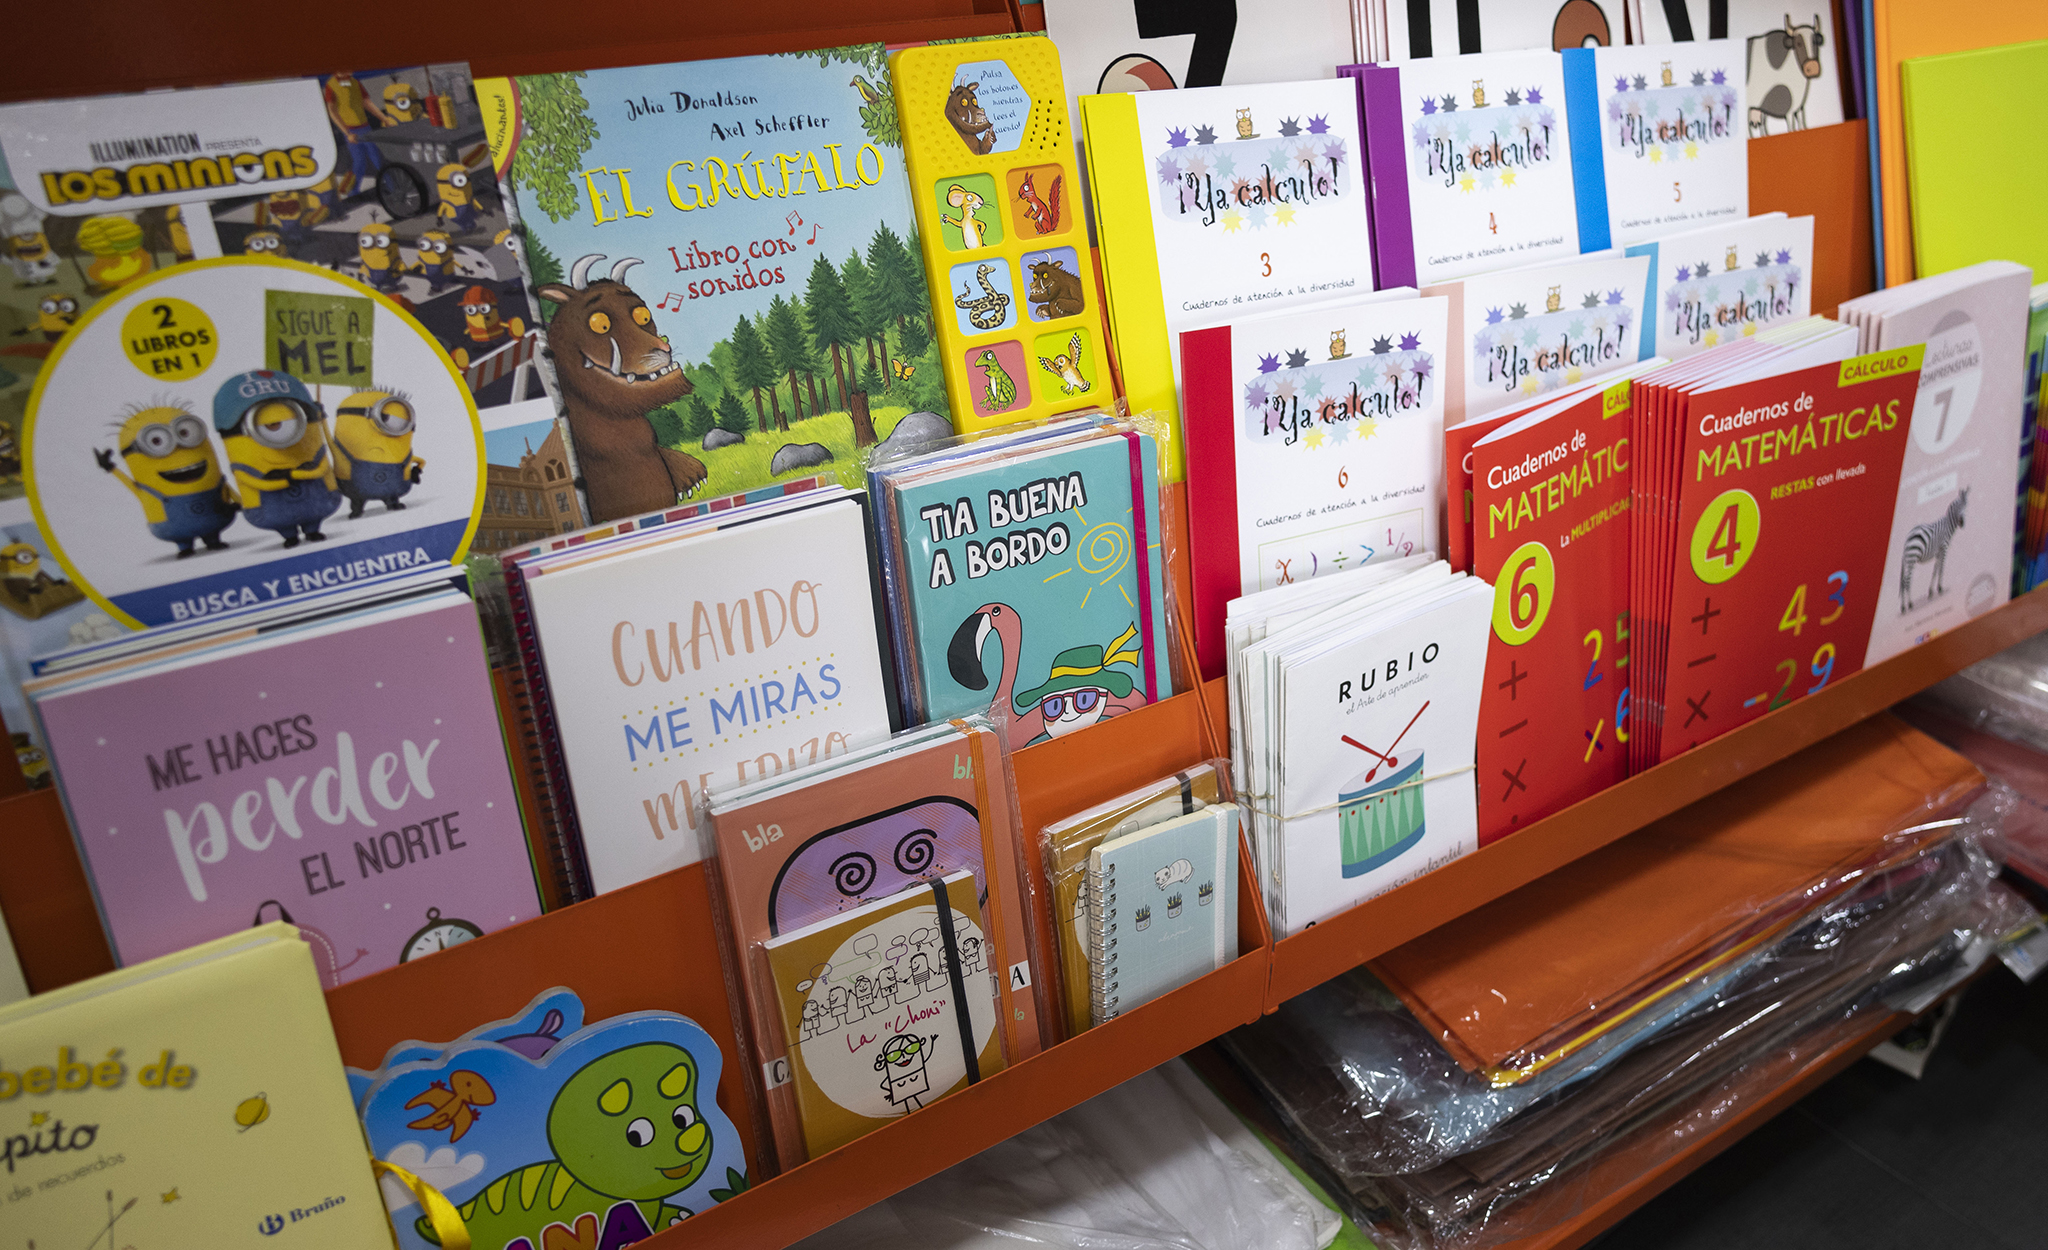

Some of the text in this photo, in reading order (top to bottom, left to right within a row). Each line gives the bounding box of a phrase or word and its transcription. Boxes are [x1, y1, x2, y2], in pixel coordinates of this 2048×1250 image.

[625, 91, 759, 121] Julia Donaldson
[710, 114, 830, 141] Axel Scheffler
[89, 132, 262, 162] ILLUMINATION PRESENTA
[1472, 125, 1550, 173] calculo!
[579, 142, 886, 227] EL GRÚFALO
[1237, 157, 1339, 208] calculo!
[1672, 182, 1682, 203] 5
[1488, 212, 1498, 235] 4
[668, 234, 797, 274] Libro con
[1260, 252, 1272, 277] 3
[688, 262, 786, 300] sonidos
[1182, 278, 1355, 312] Cuadernos de atención a la diversidad
[153, 305, 176, 329] 2
[276, 308, 361, 338] SIGUE A
[132, 328, 211, 356] LIBROS
[277, 339, 367, 377] MEL
[150, 353, 203, 375] EN 1
[1844, 354, 1908, 381] CÁLCULO
[1918, 353, 1979, 388] OMPRENSIVAS
[239, 381, 290, 398] GRU
[1323, 372, 1423, 425] calculo!
[1700, 391, 1814, 437] Cuadernos de
[1487, 442, 1567, 489] Cuadernos
[1571, 429, 1586, 452] de
[1696, 399, 1900, 483] MATEMÁTICAS
[1338, 465, 1348, 488] 6
[1770, 475, 1815, 500] RESTAS
[1816, 472, 1834, 487] con
[920, 471, 1088, 542] TIA BUENA
[1256, 511, 1302, 528] Cuadernos
[1306, 506, 1317, 517] de
[1321, 499, 1357, 514] atención
[1370, 494, 1379, 503] la
[1382, 485, 1425, 501] diversidad
[1561, 535, 1569, 548] La
[1705, 503, 1741, 569] 4
[929, 523, 1070, 589] A BORDO
[170, 546, 431, 622] BUSCA Y ENCUENTRA
[1509, 556, 1538, 631] 6
[611, 579, 822, 687] CUANDO
[1338, 642, 1440, 704] RUBIO
[623, 663, 841, 762] ME MIRAS
[145, 714, 319, 792] ME HACES
[953, 754, 974, 779] bl
[163, 730, 441, 902] perder
[300, 811, 468, 896] EL NORTE
[742, 823, 784, 853] bla
[846, 1032, 877, 1053] La
[138, 1050, 191, 1088] de
[773, 1060, 790, 1083] C
[289, 1194, 347, 1226] Bruño
